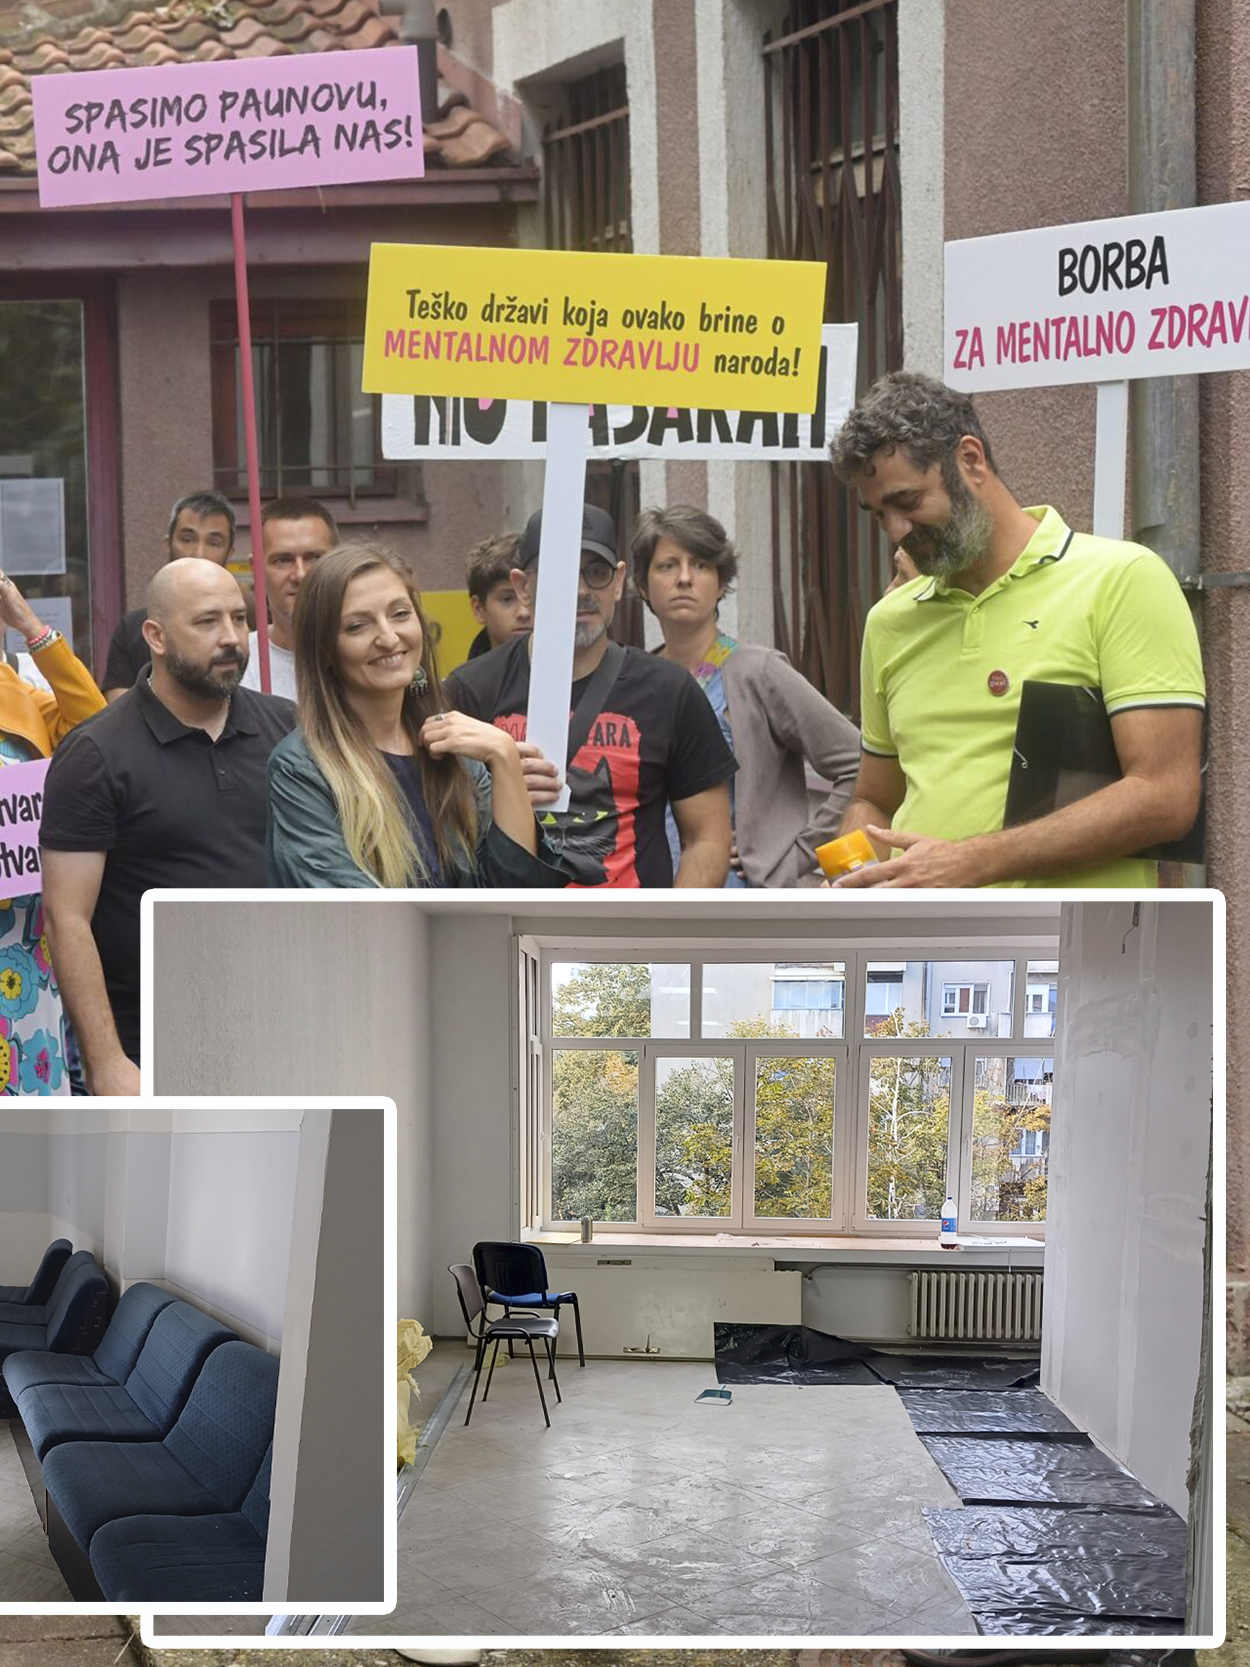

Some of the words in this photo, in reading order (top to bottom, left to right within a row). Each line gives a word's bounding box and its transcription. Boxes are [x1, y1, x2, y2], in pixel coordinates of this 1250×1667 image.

[64, 93, 207, 135] SPASIMO
[218, 80, 387, 123] PAUNOVU,
[47, 139, 120, 175] ONA
[133, 137, 173, 171] JE
[184, 124, 321, 167] SPASILA
[334, 115, 413, 152] NAS!
[1058, 235, 1170, 297] BORBA
[406, 289, 469, 322] Teško
[480, 293, 549, 325] državi
[562, 296, 609, 340] koja
[621, 301, 685, 332] ovako
[699, 303, 758, 334] brine
[771, 315, 785, 336] o
[953, 326, 985, 370] ZA
[996, 310, 1136, 366] MENTALNO
[1147, 295, 1250, 350] ZDRAV
[383, 329, 549, 365] MENTALNOM
[562, 337, 700, 373] ZDRAVLJU
[713, 346, 802, 378] naroda!
